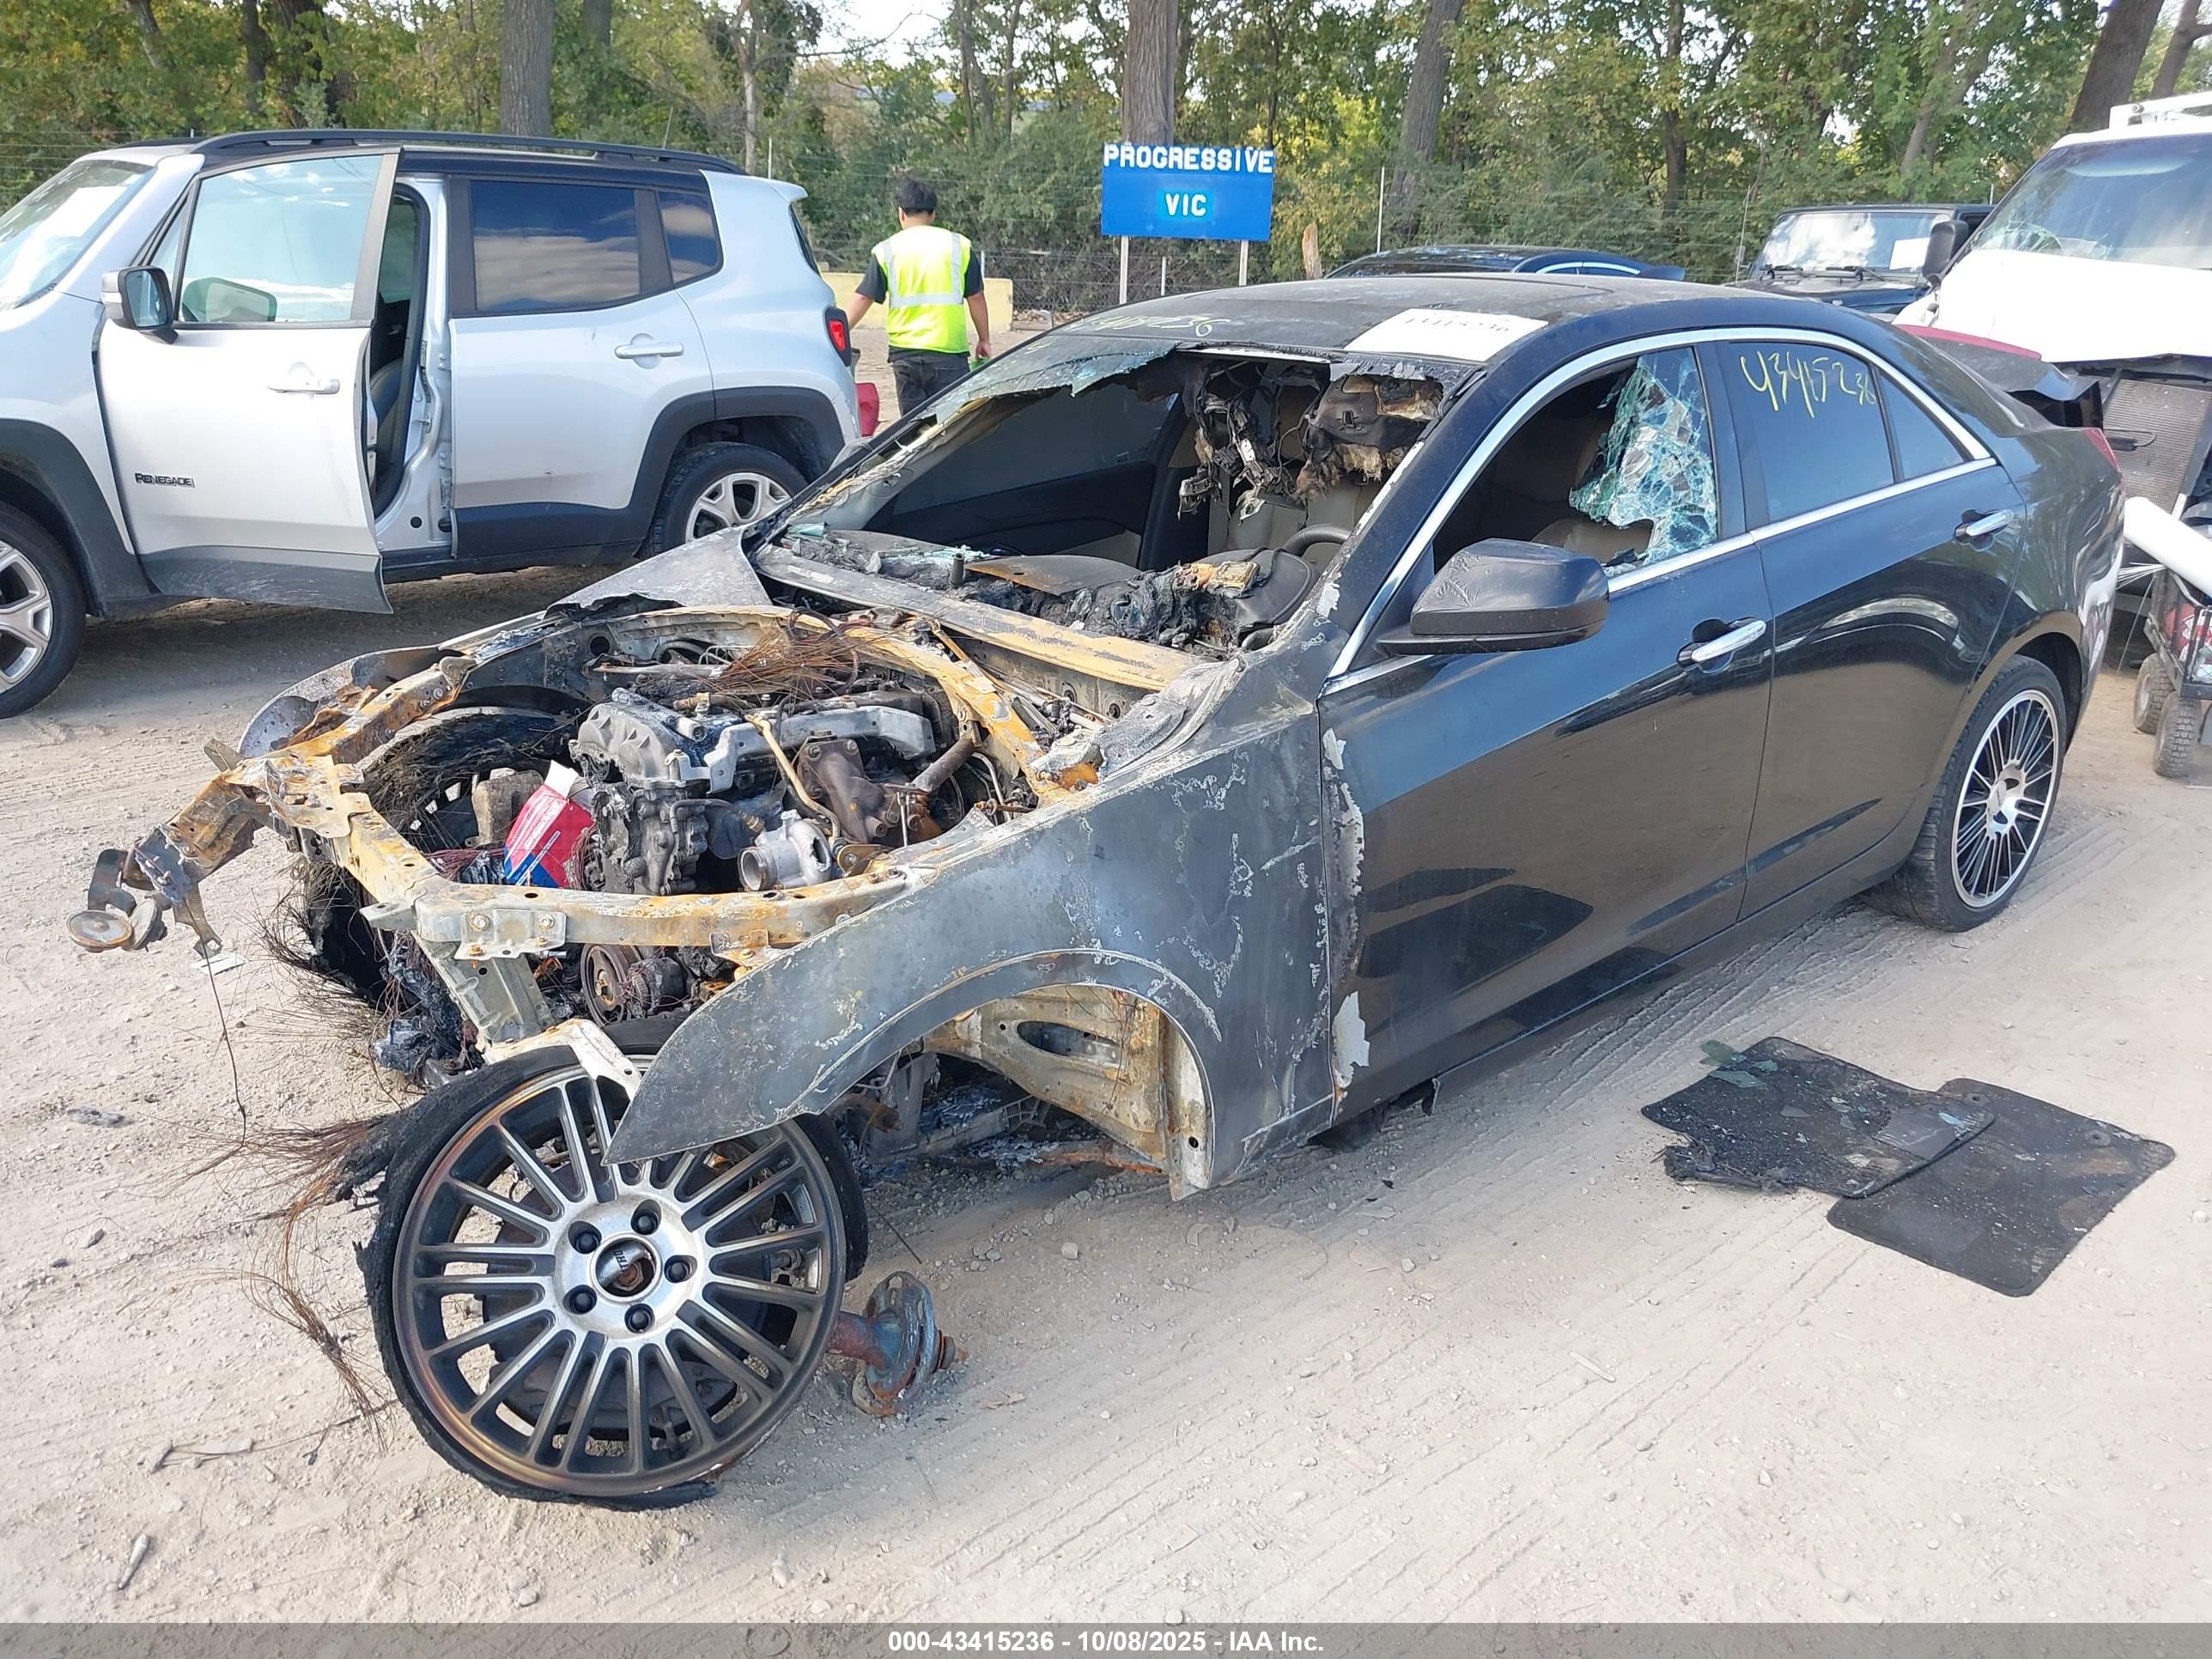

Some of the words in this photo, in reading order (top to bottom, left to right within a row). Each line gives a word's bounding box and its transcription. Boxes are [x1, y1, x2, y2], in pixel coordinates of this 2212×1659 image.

[1103, 144, 1273, 173] PROGRESSIVE
[1165, 192, 1206, 216] VIC
[134, 472, 192, 486] RENEGADE
